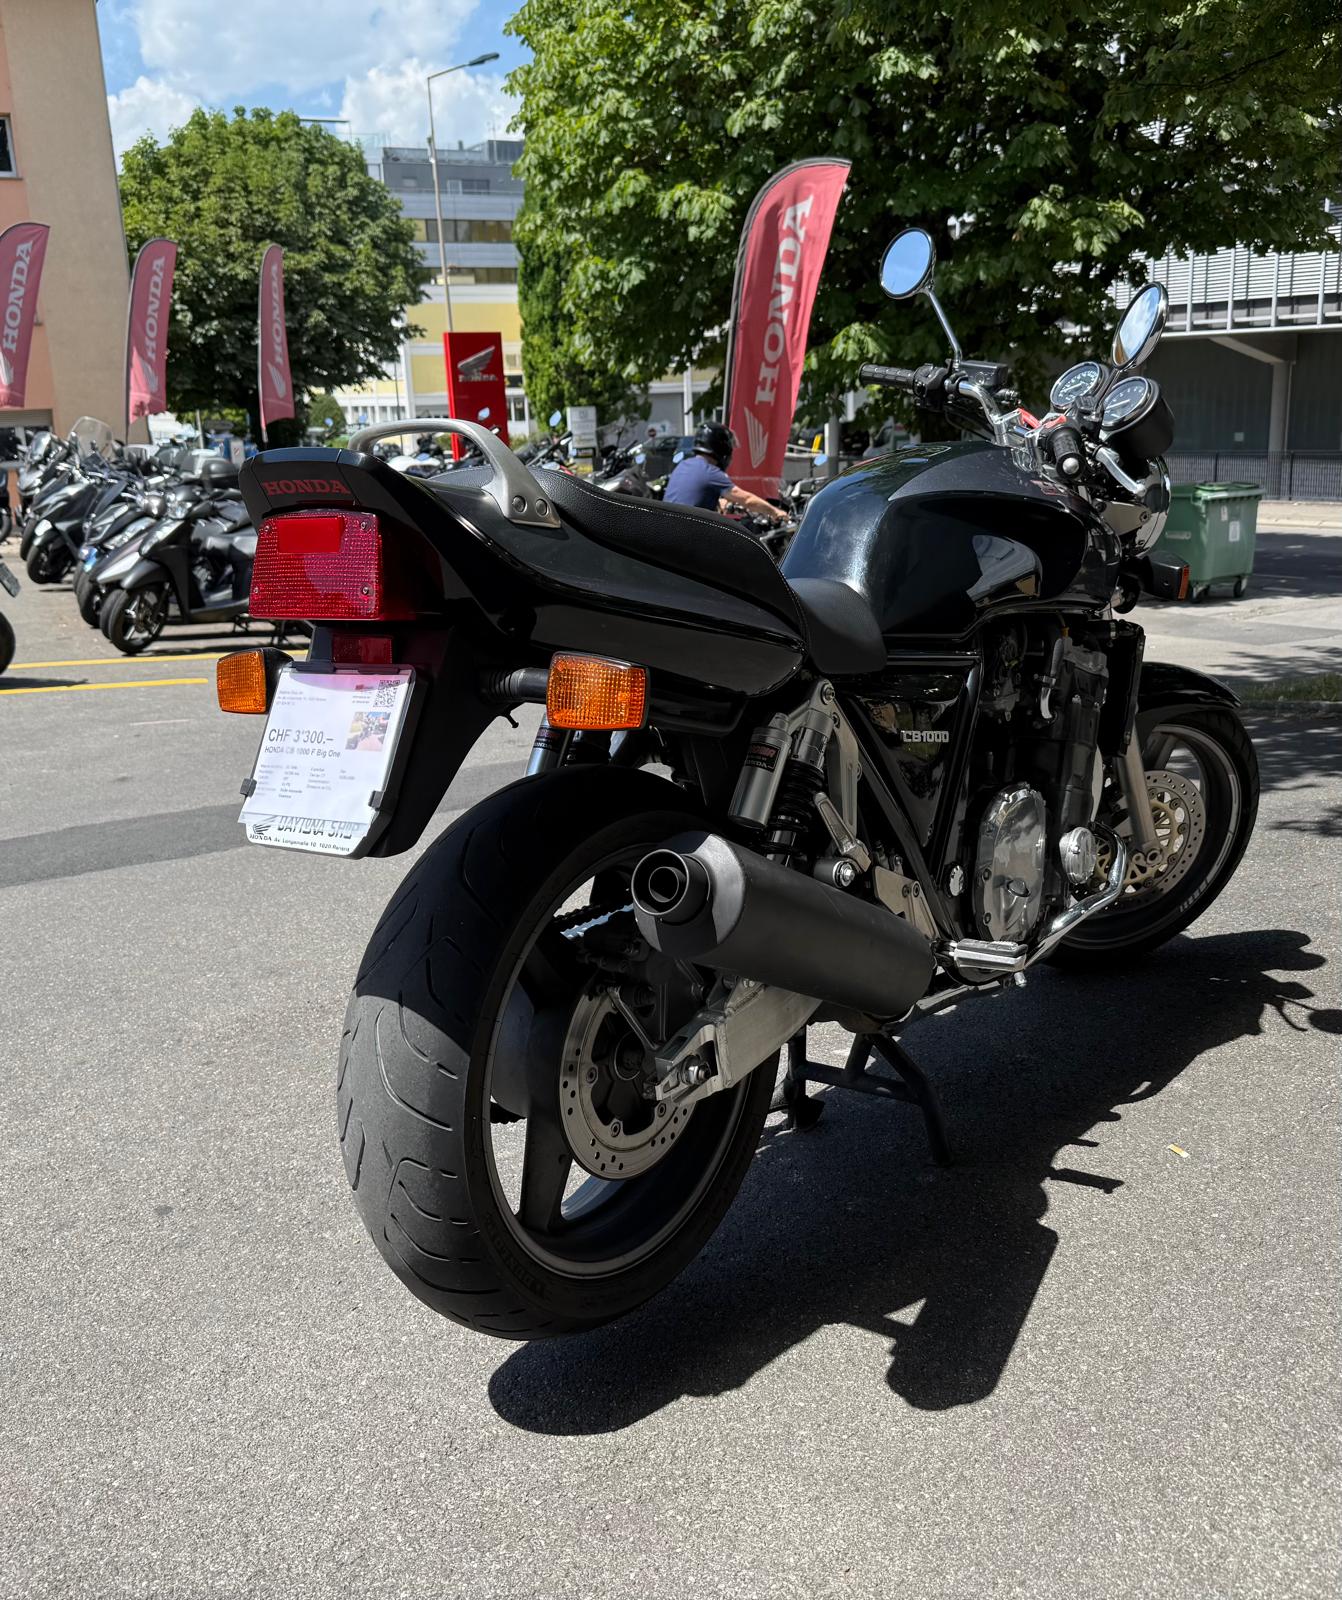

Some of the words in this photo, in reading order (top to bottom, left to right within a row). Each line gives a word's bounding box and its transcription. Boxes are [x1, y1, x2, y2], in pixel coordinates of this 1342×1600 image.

[2, 240, 34, 354] HONDA
[143, 255, 166, 362] HONDA
[271, 263, 284, 364] HONDA
[755, 195, 814, 407] HONDA
[262, 479, 351, 496] HONDA
[268, 728, 291, 742] CHF
[316, 750, 328, 759] Big
[902, 730, 950, 743] CB1000
